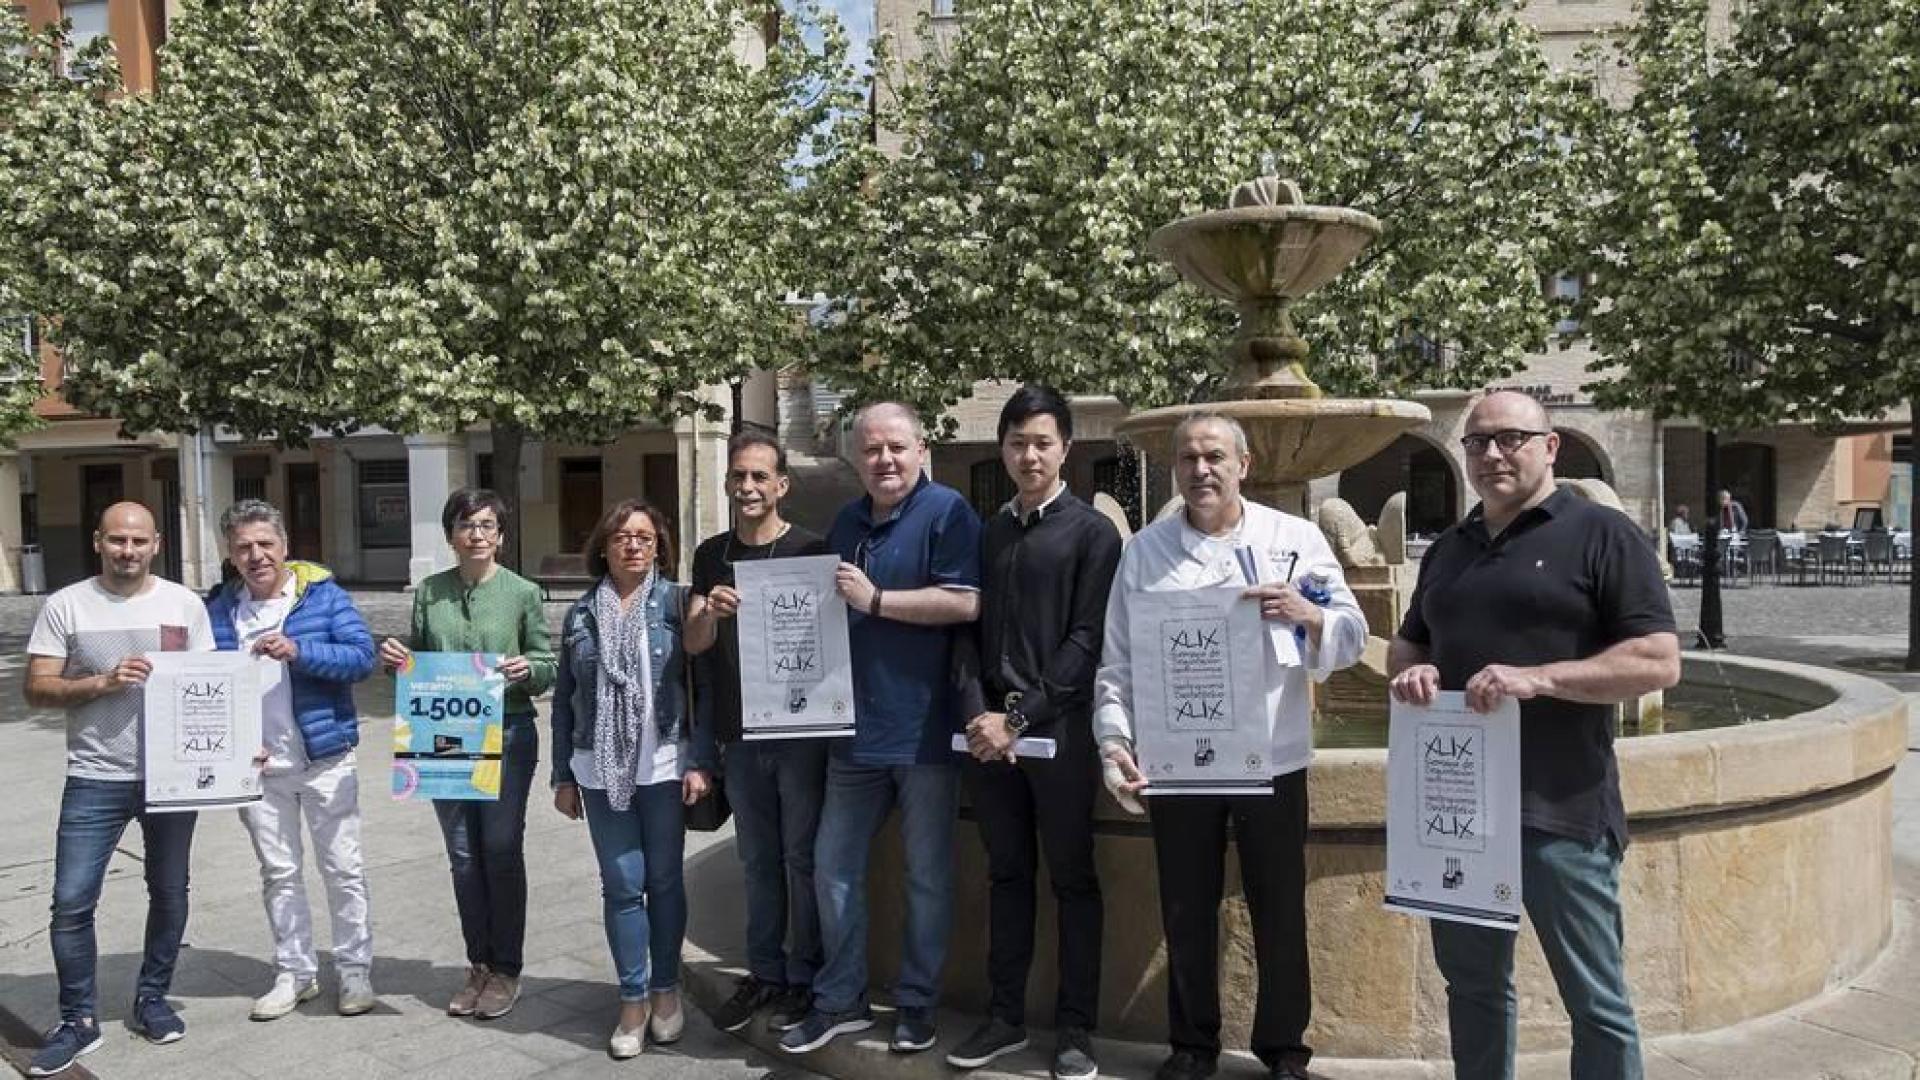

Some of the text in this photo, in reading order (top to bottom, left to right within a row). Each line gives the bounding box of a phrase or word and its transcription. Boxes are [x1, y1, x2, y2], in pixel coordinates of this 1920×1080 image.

[1169, 629, 1220, 651] XLIX
[182, 682, 224, 698] XLIX
[1176, 699, 1225, 722] XLIX
[182, 736, 226, 753] XLIX
[1424, 734, 1473, 760] XLIX
[1425, 813, 1475, 839] XLIX
